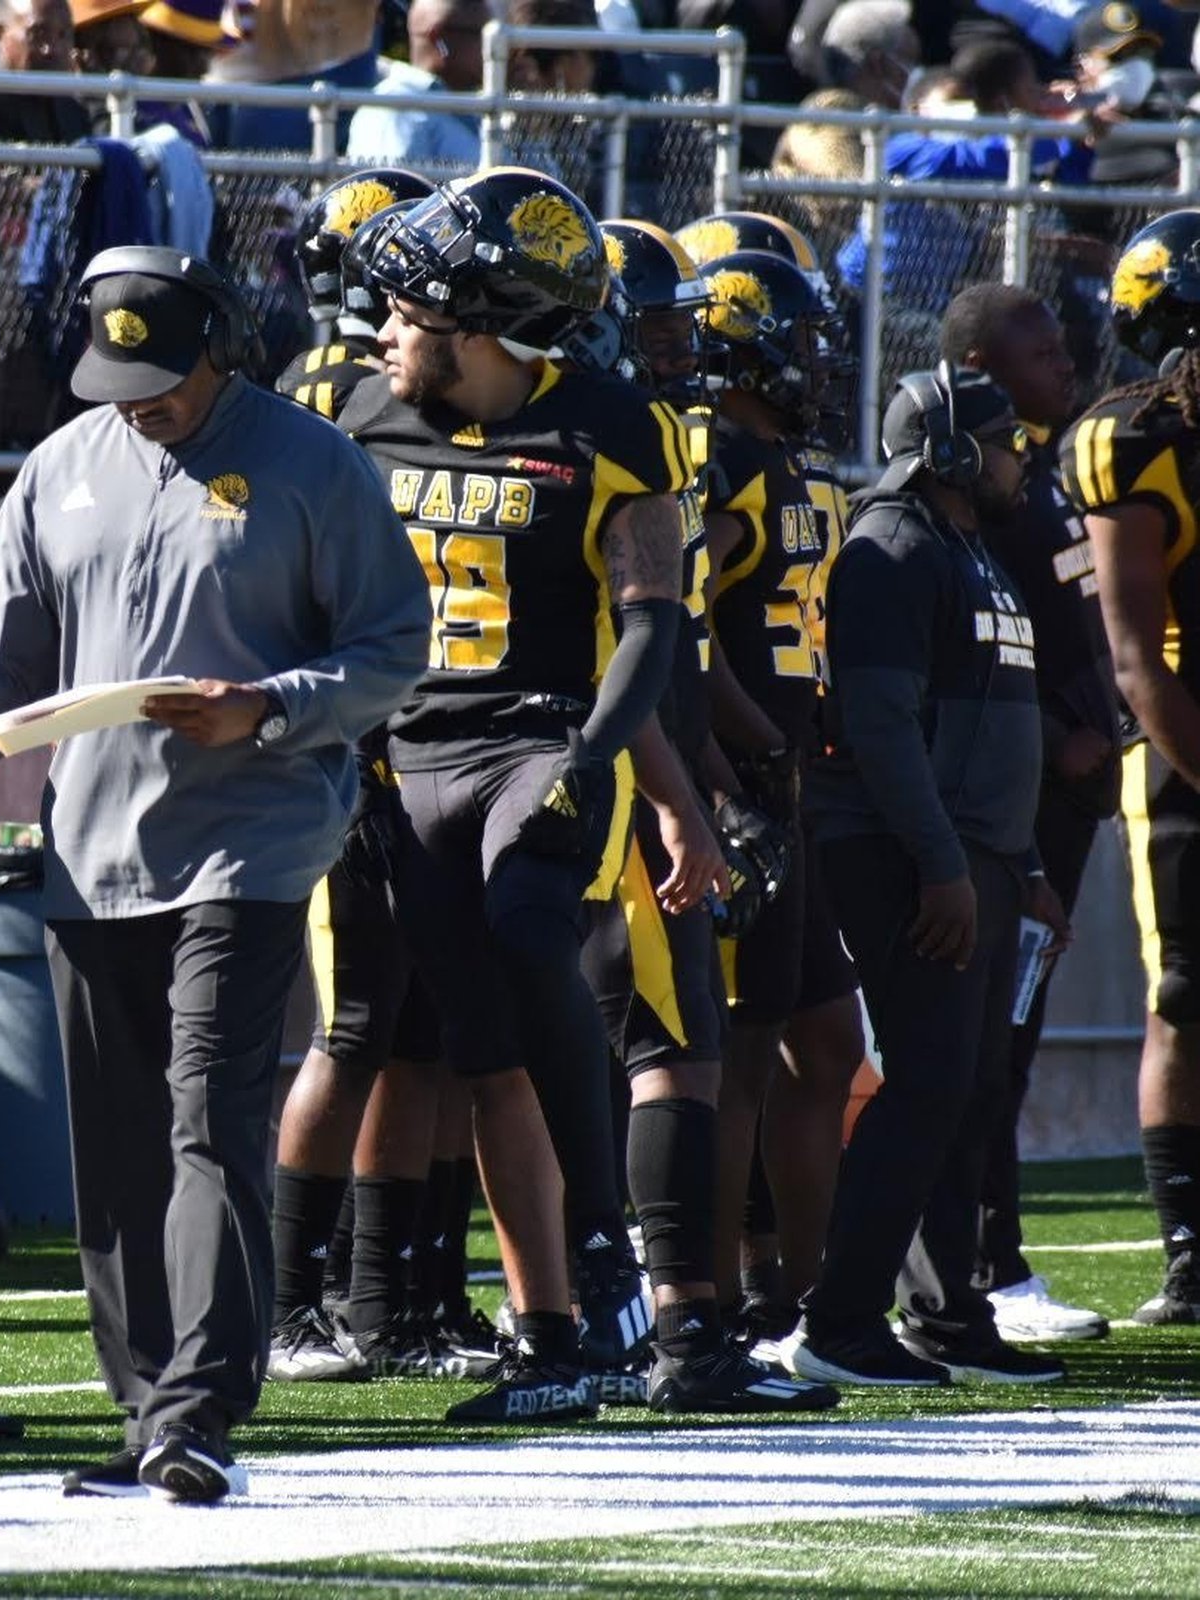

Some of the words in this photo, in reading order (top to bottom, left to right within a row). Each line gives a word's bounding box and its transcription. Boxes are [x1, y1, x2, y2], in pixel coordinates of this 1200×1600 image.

[391, 469, 536, 526] UAPB
[522, 459, 575, 482] SWAC
[406, 527, 512, 670] 19
